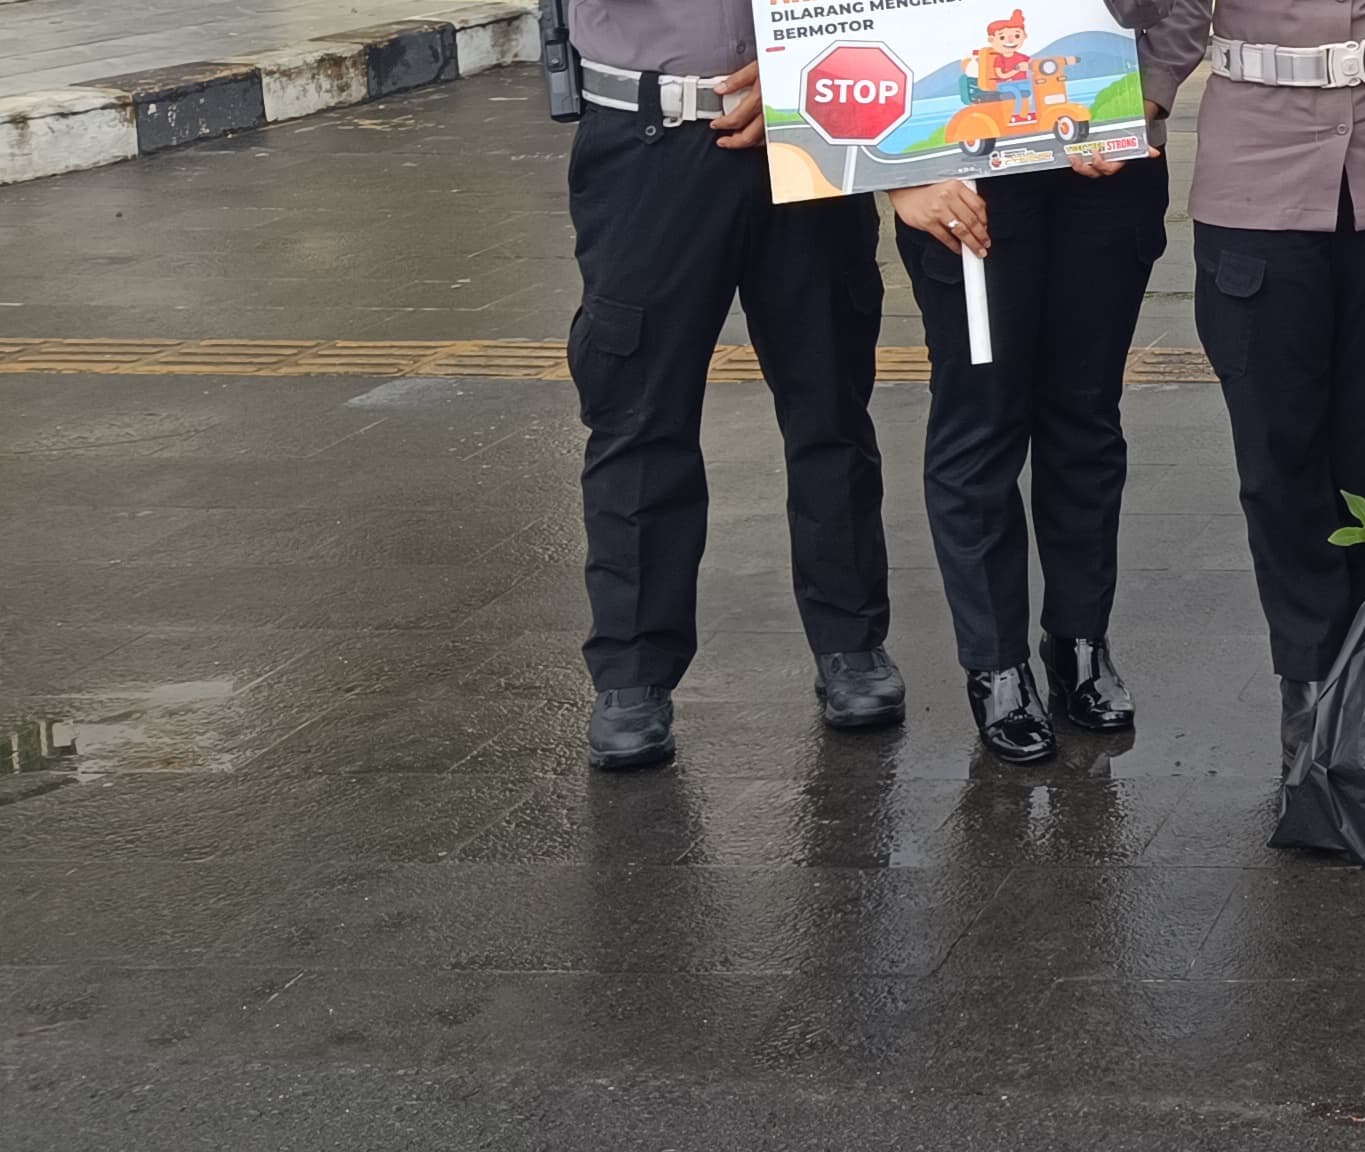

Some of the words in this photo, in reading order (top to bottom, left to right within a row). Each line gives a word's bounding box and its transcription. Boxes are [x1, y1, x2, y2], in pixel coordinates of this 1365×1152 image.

[771, 1, 865, 23] DILARANG
[773, 19, 874, 41] BERMOTOR
[814, 78, 898, 104] STOP
